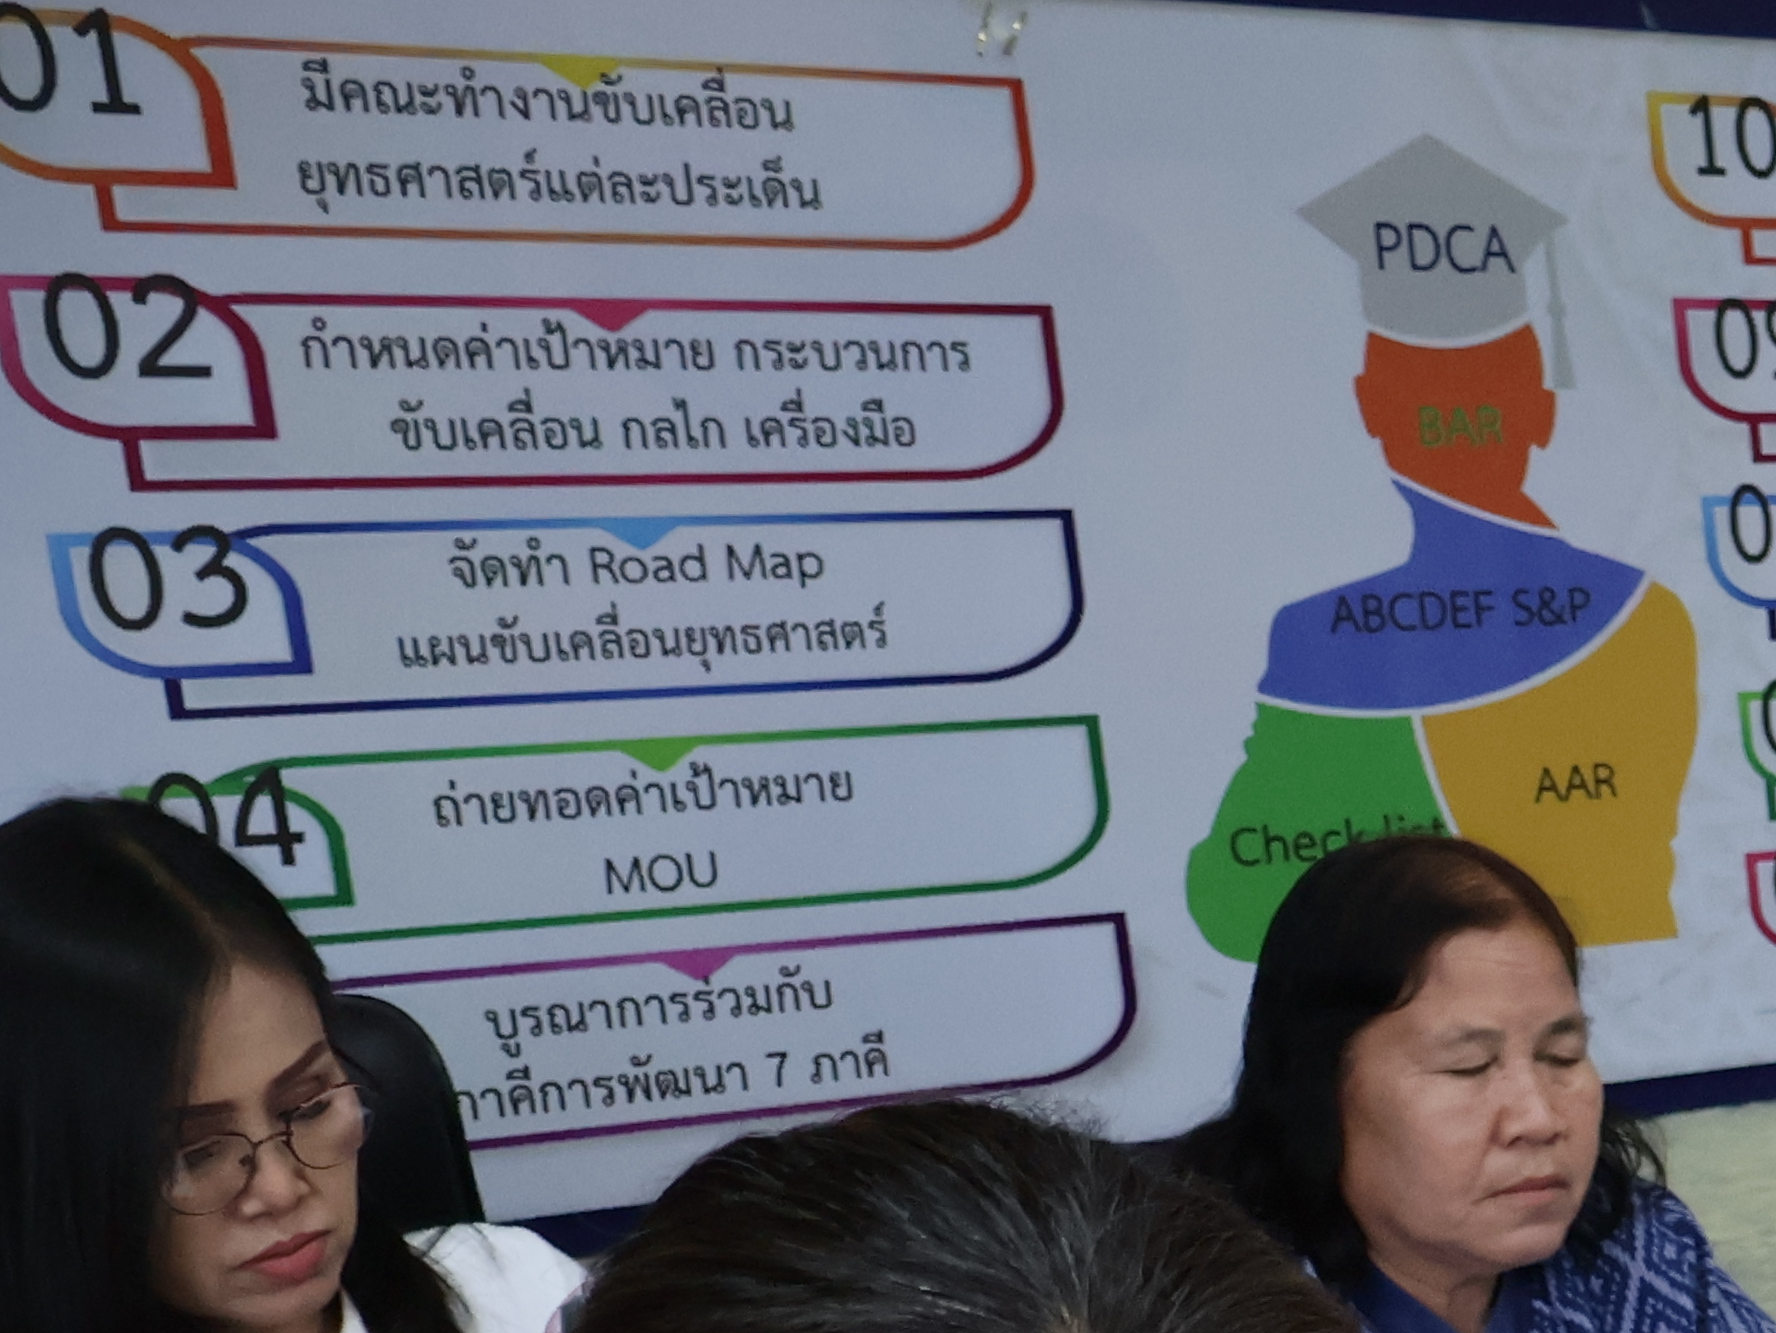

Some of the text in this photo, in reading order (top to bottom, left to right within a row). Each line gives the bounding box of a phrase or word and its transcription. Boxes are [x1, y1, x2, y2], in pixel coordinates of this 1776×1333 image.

[0, 5, 141, 117] 01
[300, 66, 795, 131] มีคณะทำงานขับเคลื่อน
[297, 152, 822, 214] ยุทธศาสตร์แต่ละประเด็น
[1374, 222, 1517, 274] PDCA
[42, 272, 214, 380] 02
[300, 319, 971, 377] กำหนดค่าเป้าหมาย กระบวนการ
[389, 391, 916, 455] ขับเคลื่อน กลไก เครื่องมือ
[1418, 405, 1505, 449] BAR
[89, 525, 248, 630] 03
[448, 538, 825, 594] จัดทำ Road Map
[398, 602, 889, 675] แผนขับเคลื่อนยุทธศาสตร์
[1331, 588, 1593, 635] ABCDEF S&P
[431, 766, 855, 832] ถ่ายทอดค่าเป้าหมาย
[1535, 763, 1617, 803] AAR
[603, 850, 720, 897] MOU
[485, 964, 834, 1059] บูรณาการร่วมกับ
[765, 1052, 788, 1087] 7
[810, 1029, 890, 1086] ภาคี
